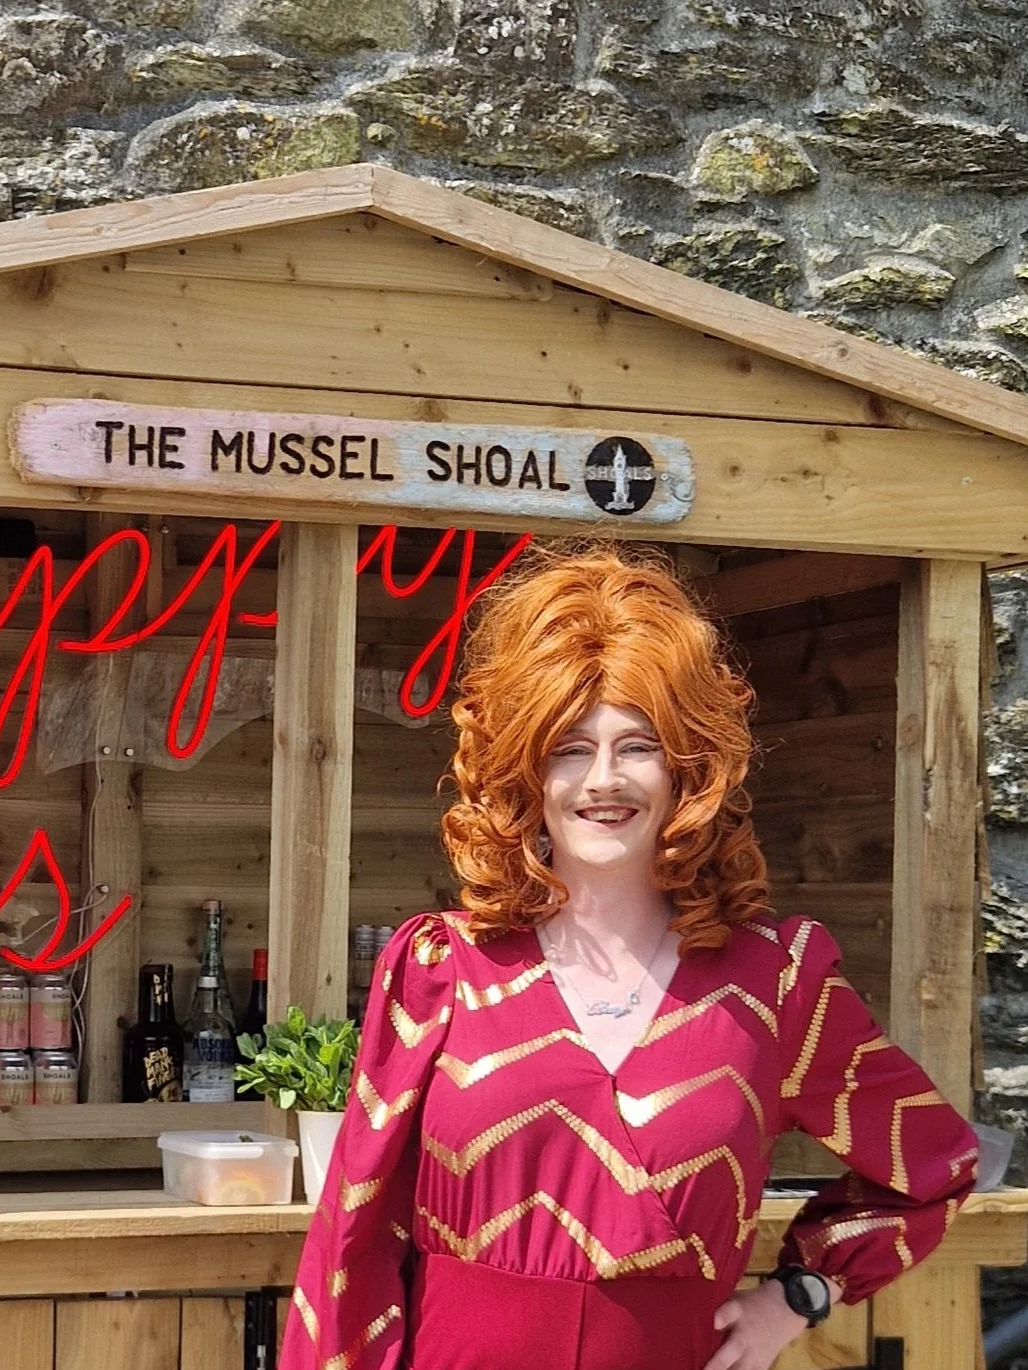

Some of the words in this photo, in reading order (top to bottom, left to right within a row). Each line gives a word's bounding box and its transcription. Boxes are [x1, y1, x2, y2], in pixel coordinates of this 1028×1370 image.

[95, 420, 186, 471] THE
[209, 429, 395, 483] MUSSEL
[427, 439, 571, 493] SHOAL
